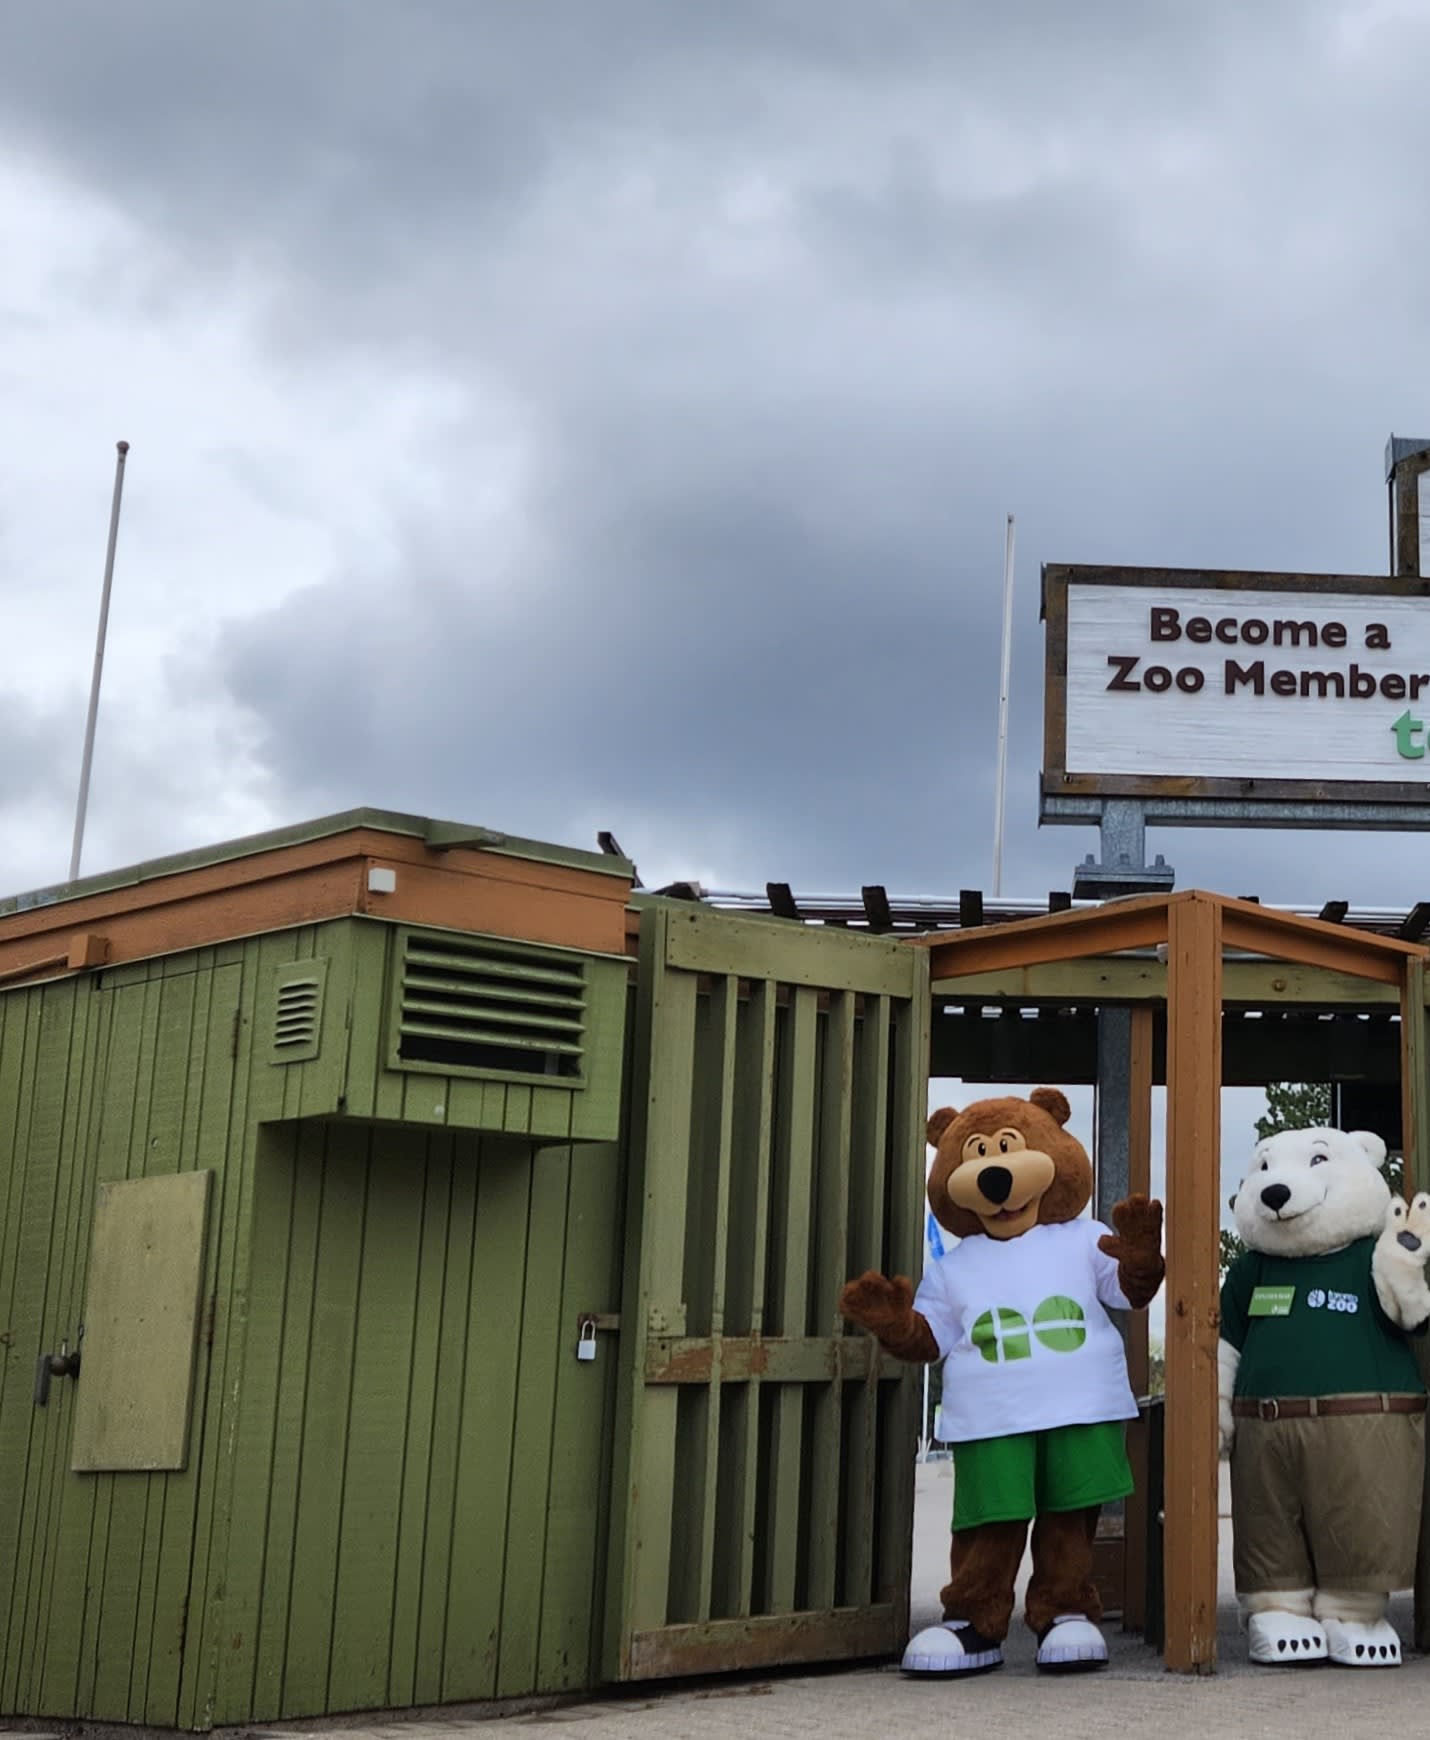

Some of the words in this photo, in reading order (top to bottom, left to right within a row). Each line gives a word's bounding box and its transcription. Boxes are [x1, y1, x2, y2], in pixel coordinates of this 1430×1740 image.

[1150, 606, 1348, 649] Become
[1364, 623, 1392, 651] a
[1105, 655, 1206, 695] Zoo
[1224, 659, 1430, 701] Member
